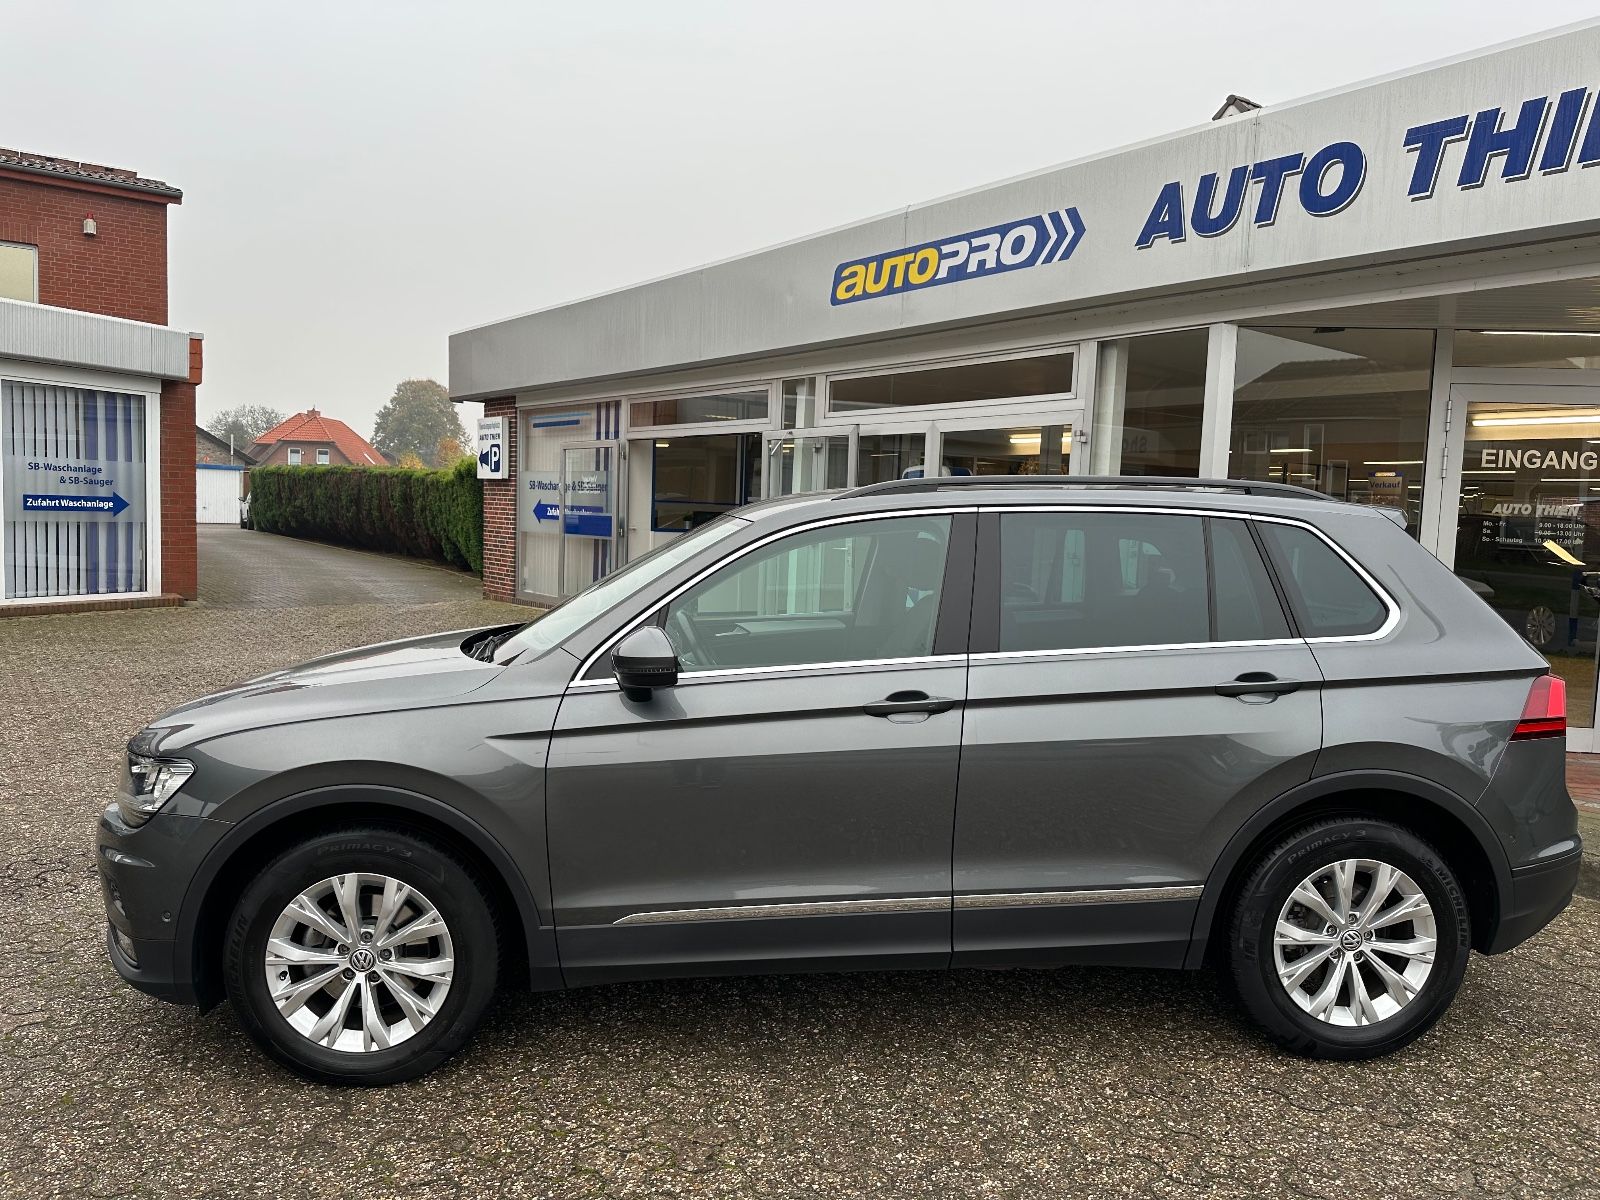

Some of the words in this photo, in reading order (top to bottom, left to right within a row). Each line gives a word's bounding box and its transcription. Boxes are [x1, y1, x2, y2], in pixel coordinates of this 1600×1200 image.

[1134, 141, 1368, 250] AUTO
[1403, 86, 1600, 203] THI
[1481, 449, 1598, 470] EINGANG
[27, 462, 103, 476] SB-Waschanlage
[60, 476, 67, 484] &
[68, 476, 114, 488] SB-Sauger
[26, 498, 60, 507] Zufahrt
[60, 499, 114, 509] Waschanlage
[1492, 503, 1532, 515] AUTO
[1537, 504, 1580, 517] THIEN
[317, 842, 396, 857] PRIMACY
[1287, 831, 1350, 865] PRIMACY
[1356, 829, 1368, 839] 3
[1436, 866, 1470, 949] MICHELIN
